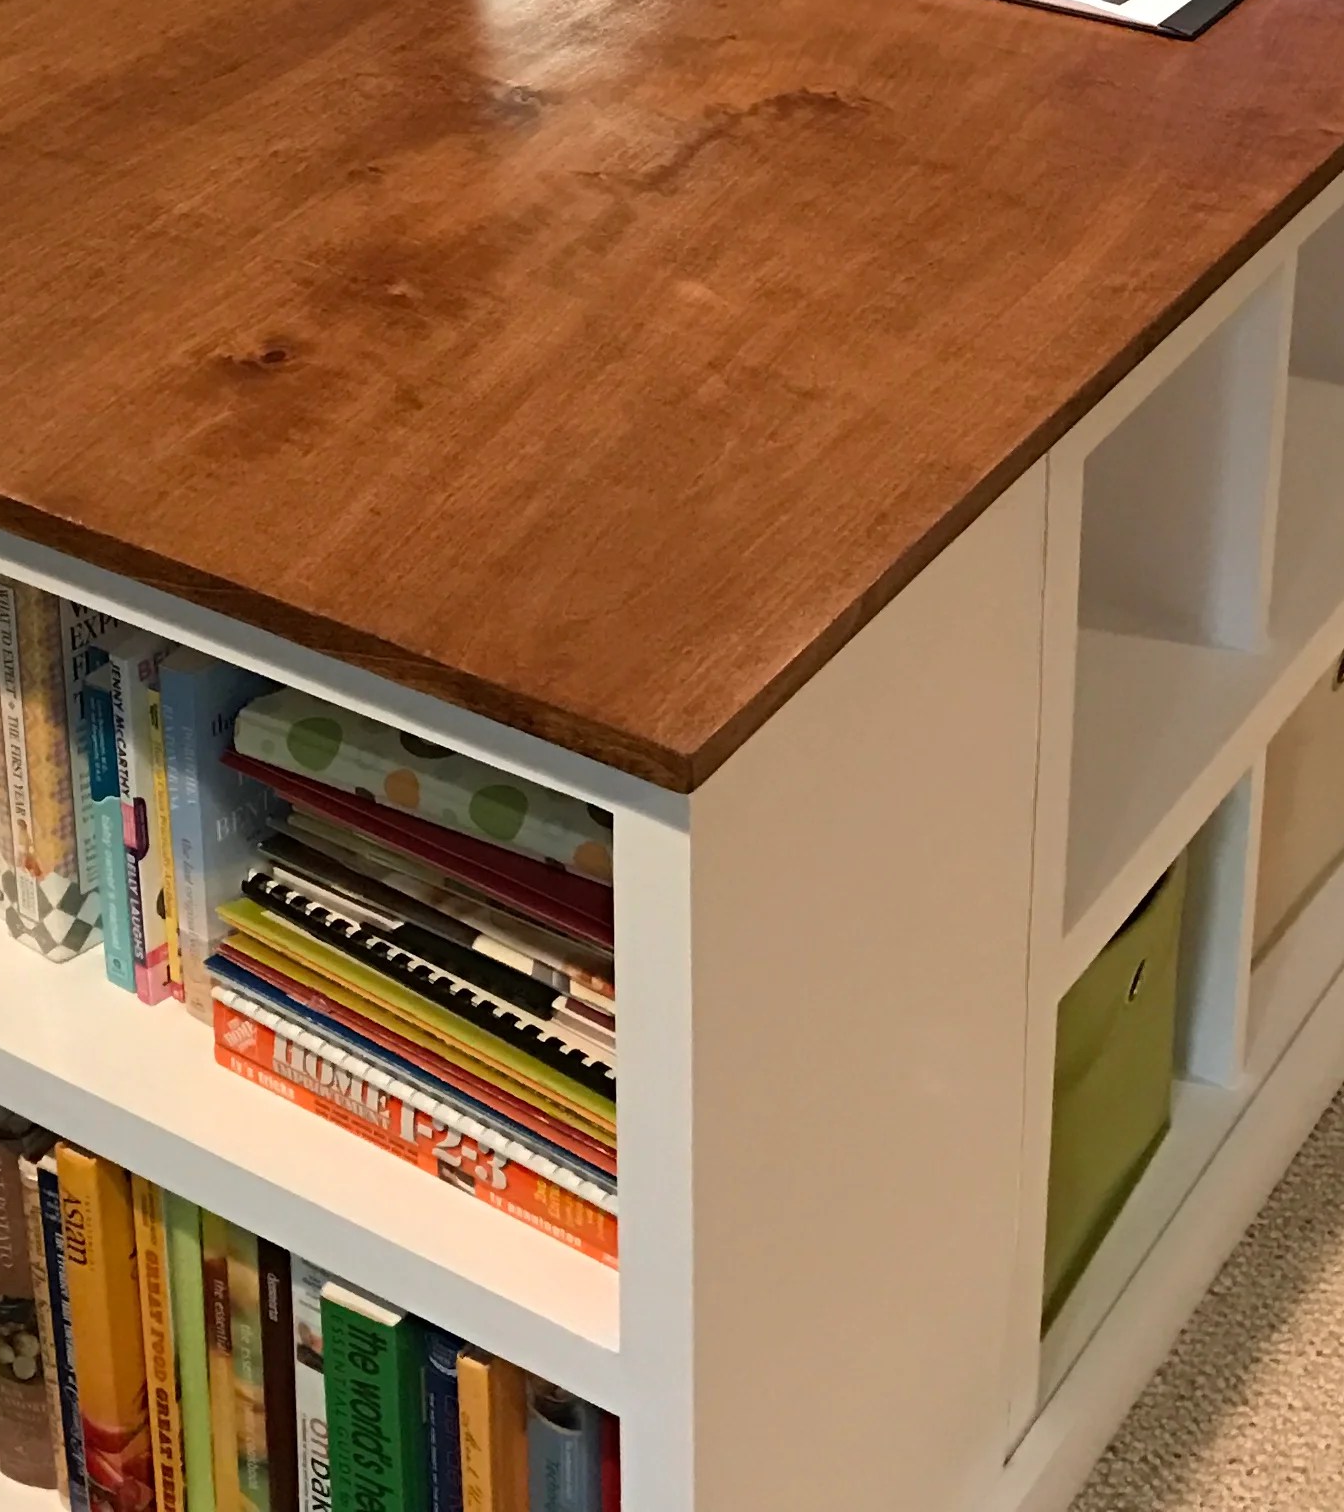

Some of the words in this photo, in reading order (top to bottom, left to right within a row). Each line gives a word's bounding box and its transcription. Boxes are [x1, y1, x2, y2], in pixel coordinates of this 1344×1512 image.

[0, 631, 13, 650] TO
[2, 650, 18, 700] EXPECT
[110, 660, 124, 713] JENNY
[7, 715, 20, 741] THE
[10, 745, 23, 782] FIRST
[13, 783, 27, 817] YEAR
[126, 854, 140, 899] BELLY
[129, 899, 146, 961] LAUGHS
[272, 1058, 392, 1131] IMPROVEMENT
[273, 1032, 391, 1118] HOME
[399, 1100, 509, 1191] 1-2-3
[144, 1249, 164, 1324] GREAT
[212, 1278, 225, 1299] the
[149, 1326, 169, 1386] FOOD
[213, 1300, 231, 1358] essential
[239, 1323, 254, 1345] the
[347, 1323, 389, 1377] the
[330, 1313, 349, 1420] ESSENTIAL
[155, 1387, 175, 1463] GREAT
[350, 1377, 394, 1479] world's
[336, 1425, 354, 1486] GUIDE
